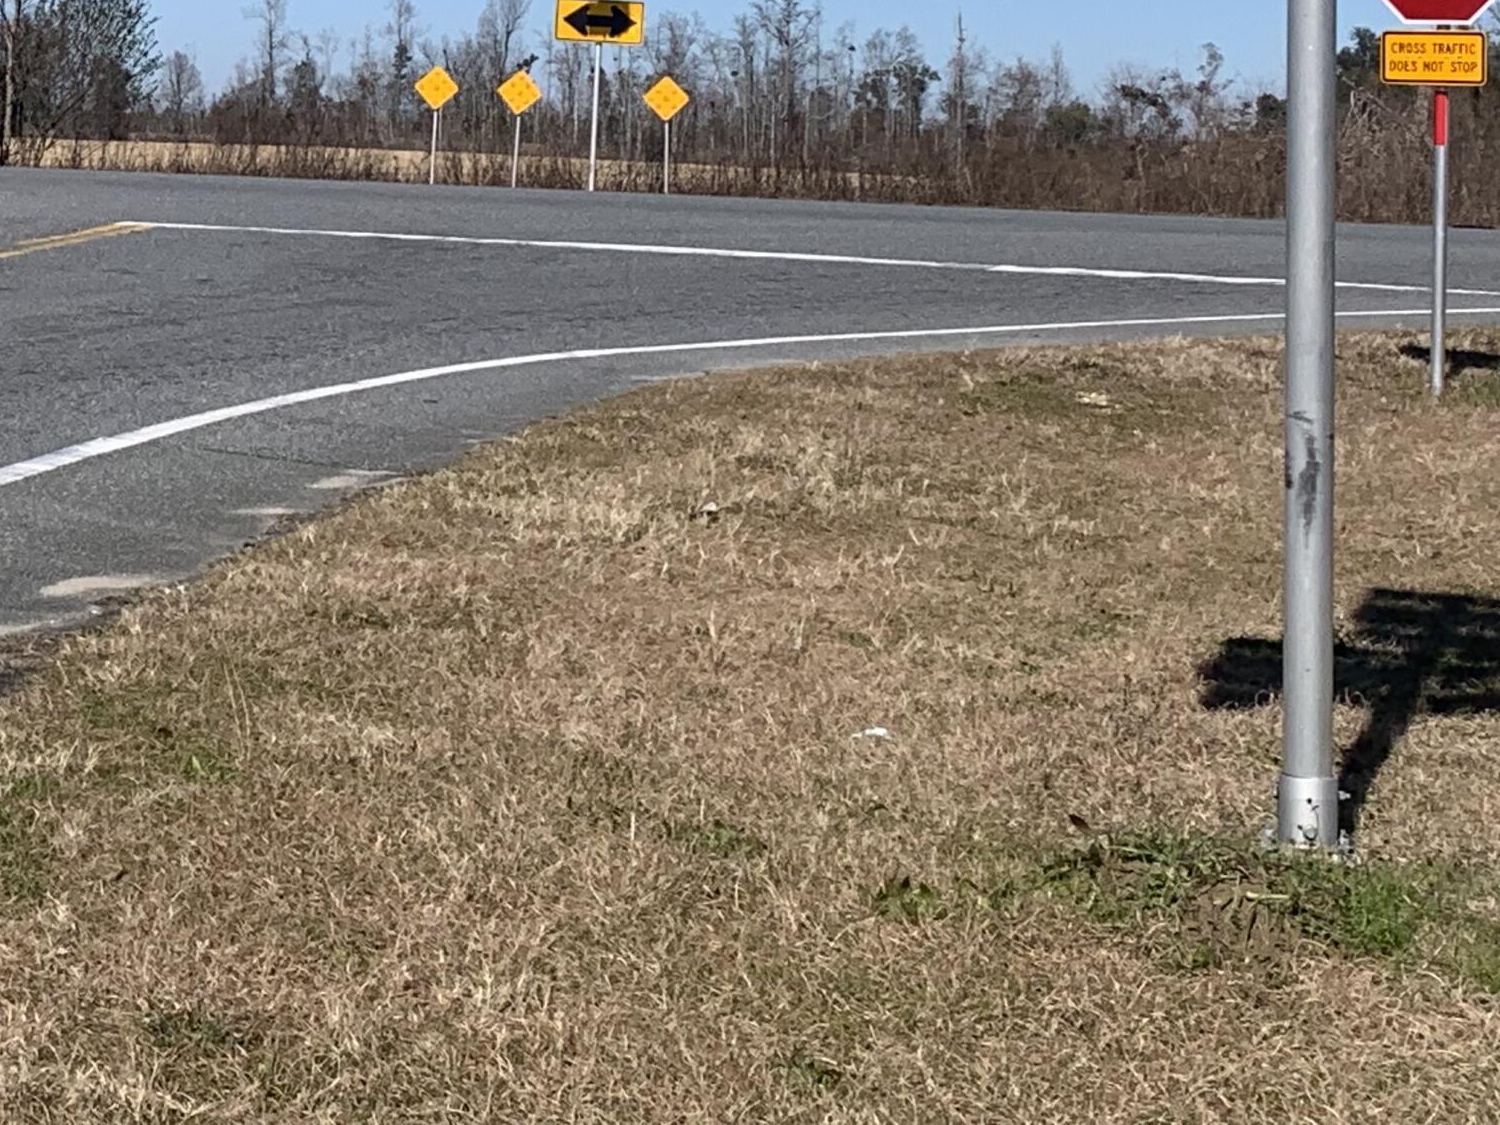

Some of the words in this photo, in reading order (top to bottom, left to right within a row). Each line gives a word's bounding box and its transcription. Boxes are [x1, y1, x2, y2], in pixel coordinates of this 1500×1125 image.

[1390, 42, 1426, 54] CROSS
[1432, 42, 1476, 55] TRAFFIC
[1389, 60, 1418, 72] DOES
[1423, 60, 1444, 72] NOT
[1450, 61, 1478, 73] STOP
